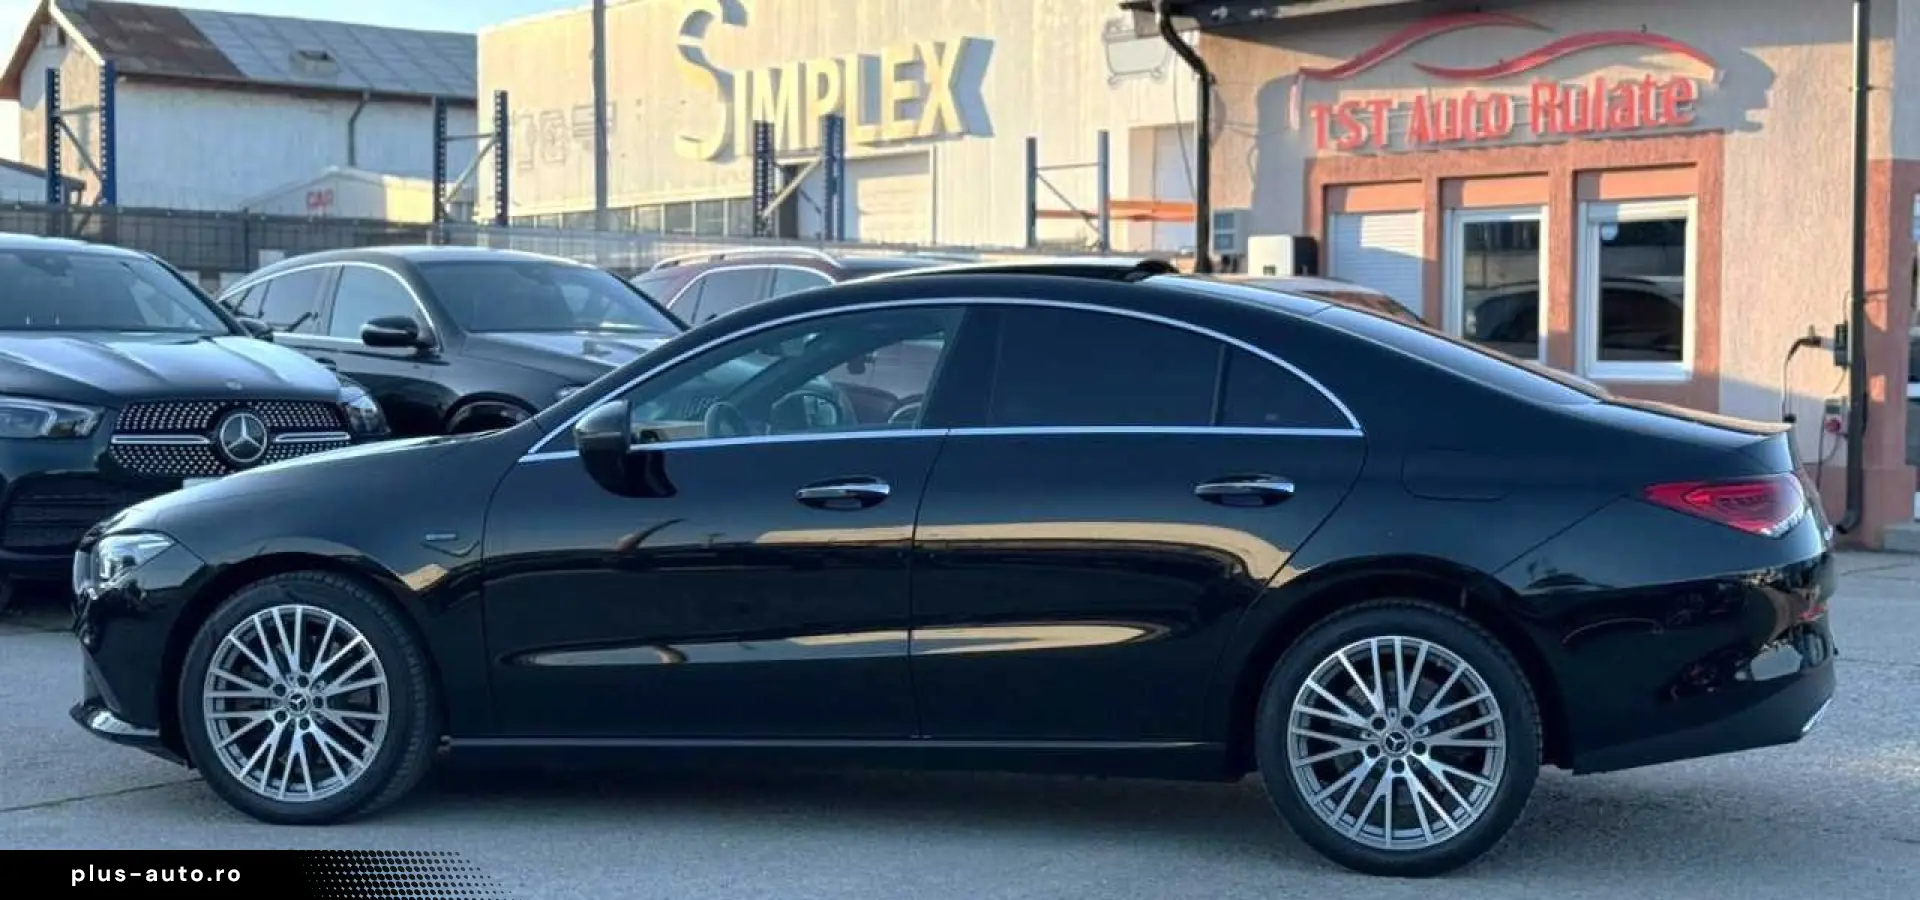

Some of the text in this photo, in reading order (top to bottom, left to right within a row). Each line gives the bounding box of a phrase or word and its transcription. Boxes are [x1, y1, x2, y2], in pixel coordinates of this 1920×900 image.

[673, 0, 968, 162] SIMPLEX
[1406, 91, 1512, 144] Auto
[1529, 73, 1698, 134] Rulate
